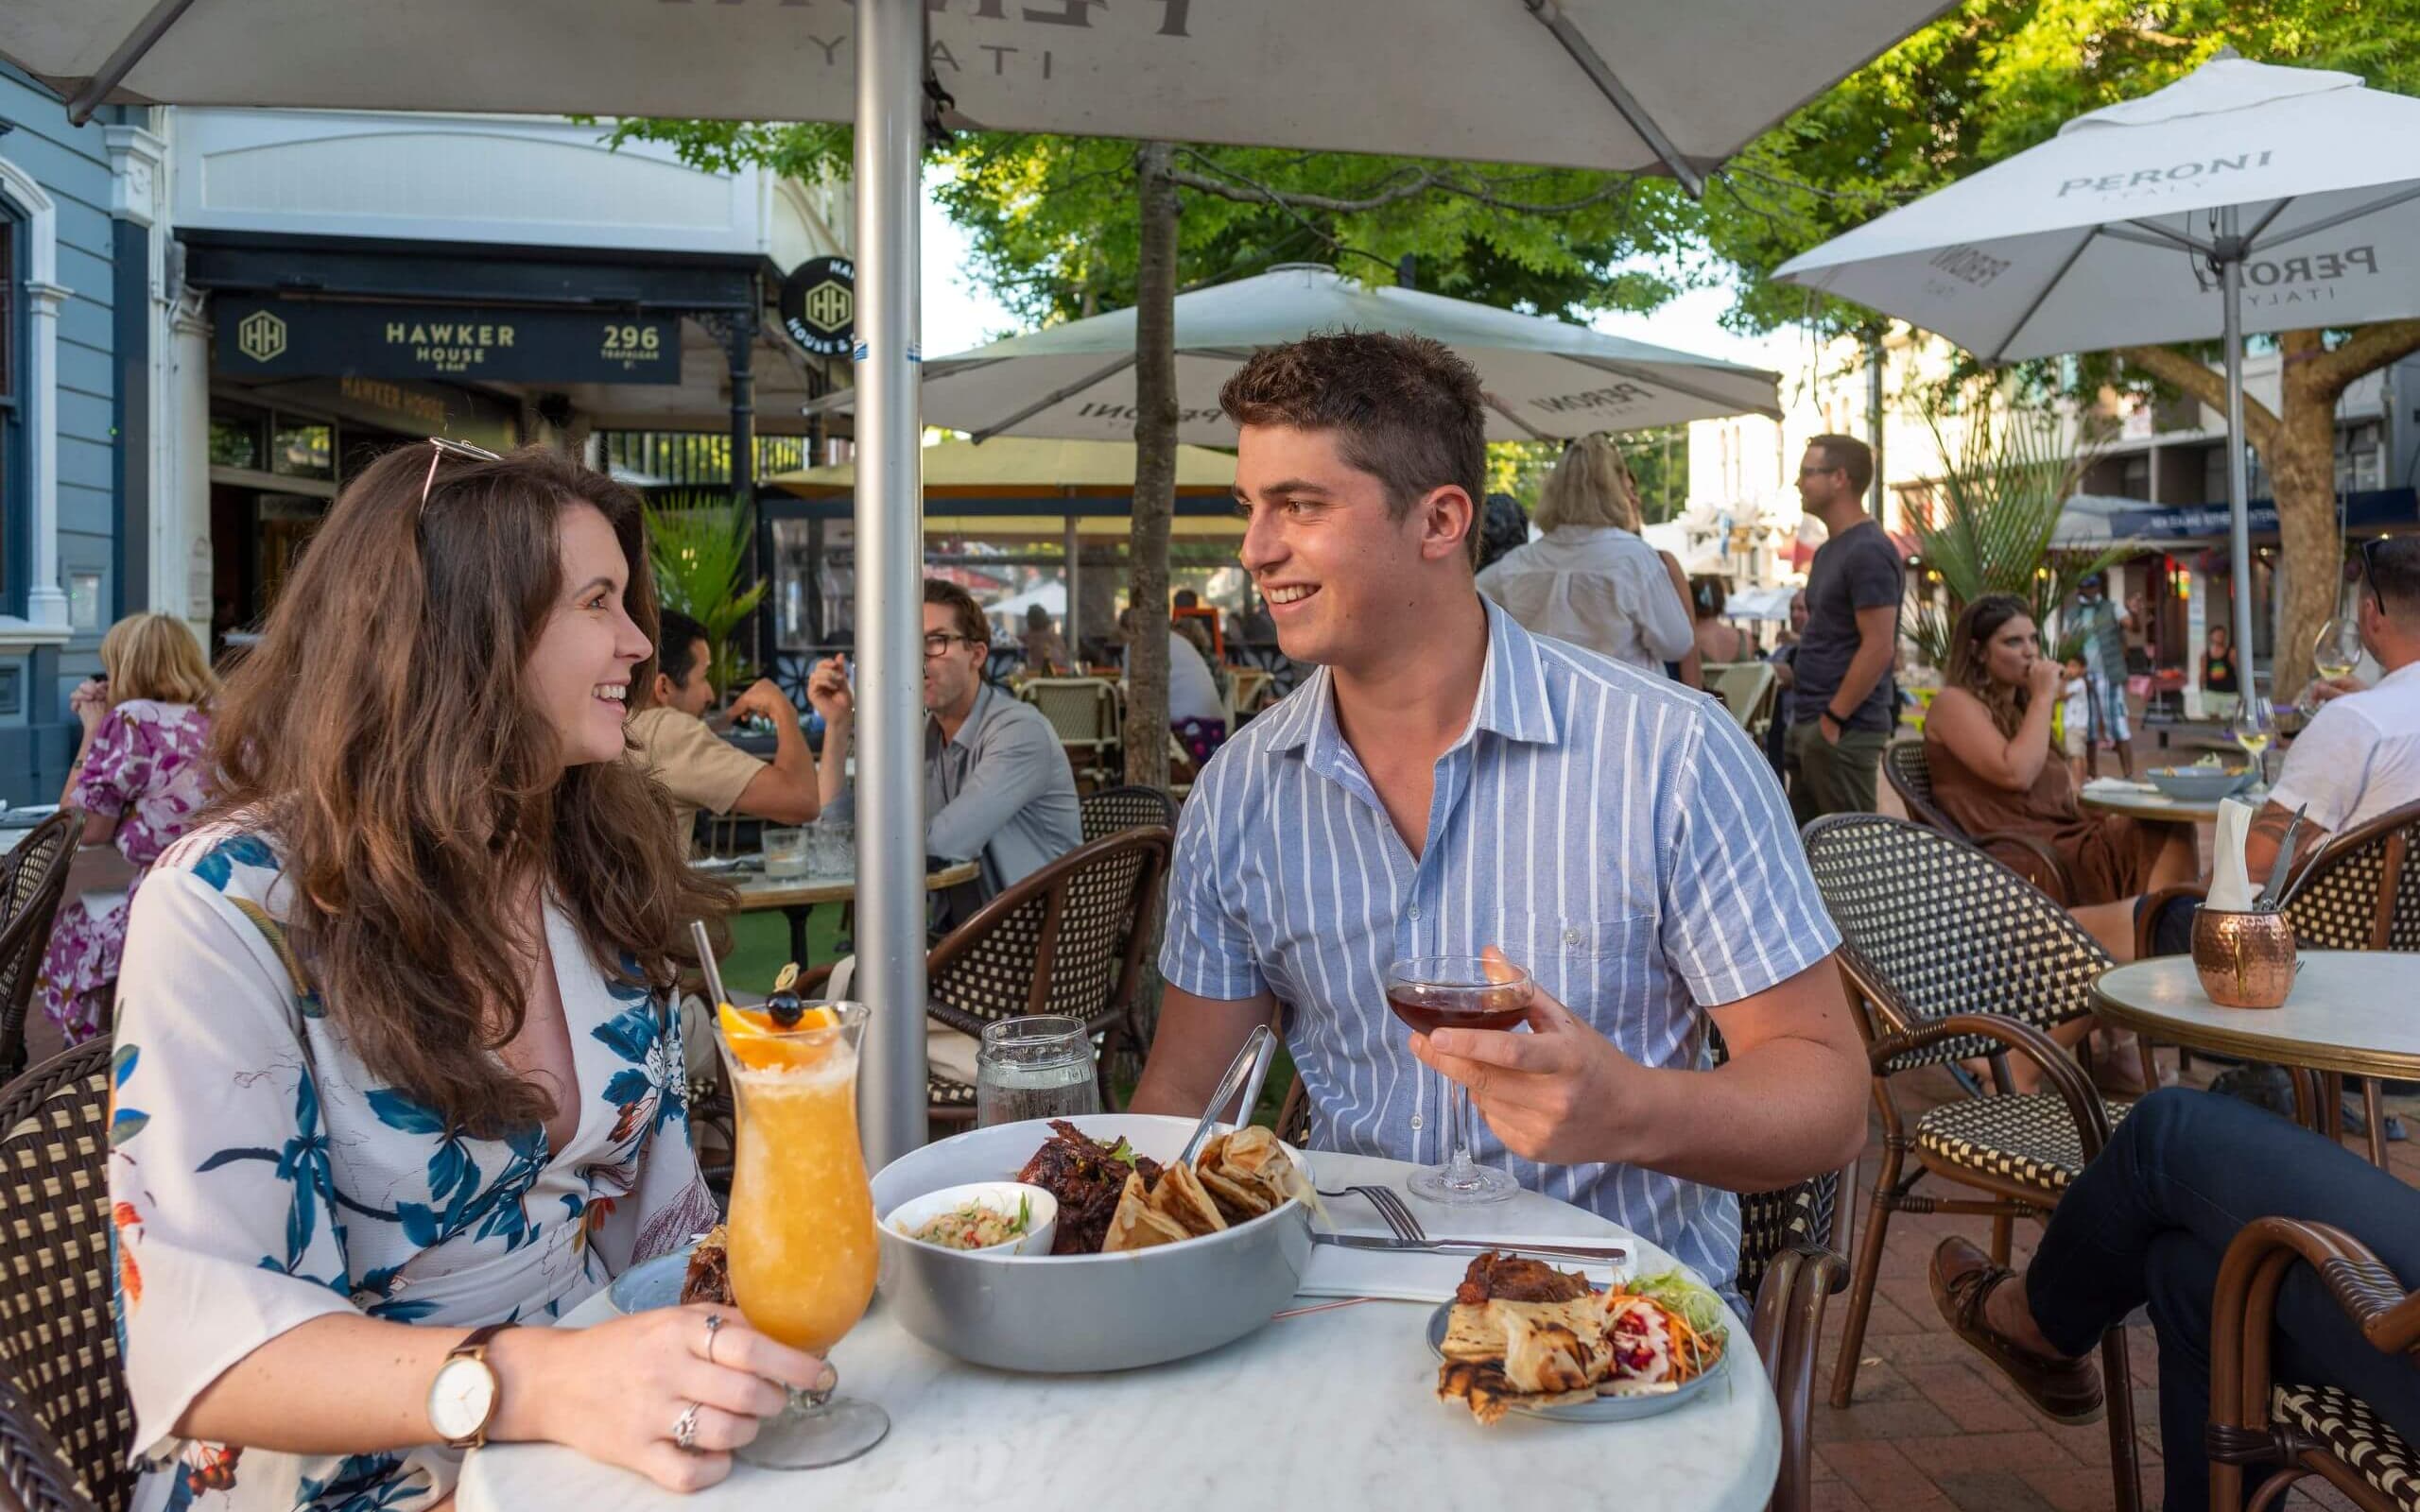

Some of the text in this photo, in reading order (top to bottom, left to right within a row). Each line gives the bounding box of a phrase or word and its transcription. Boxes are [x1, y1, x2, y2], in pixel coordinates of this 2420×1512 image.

[2057, 149, 2273, 198] PERONI
[386, 322, 515, 347] HAWKER
[603, 324, 659, 350] 296
[786, 317, 833, 353] HOUSE
[416, 347, 485, 363] HOUSE
